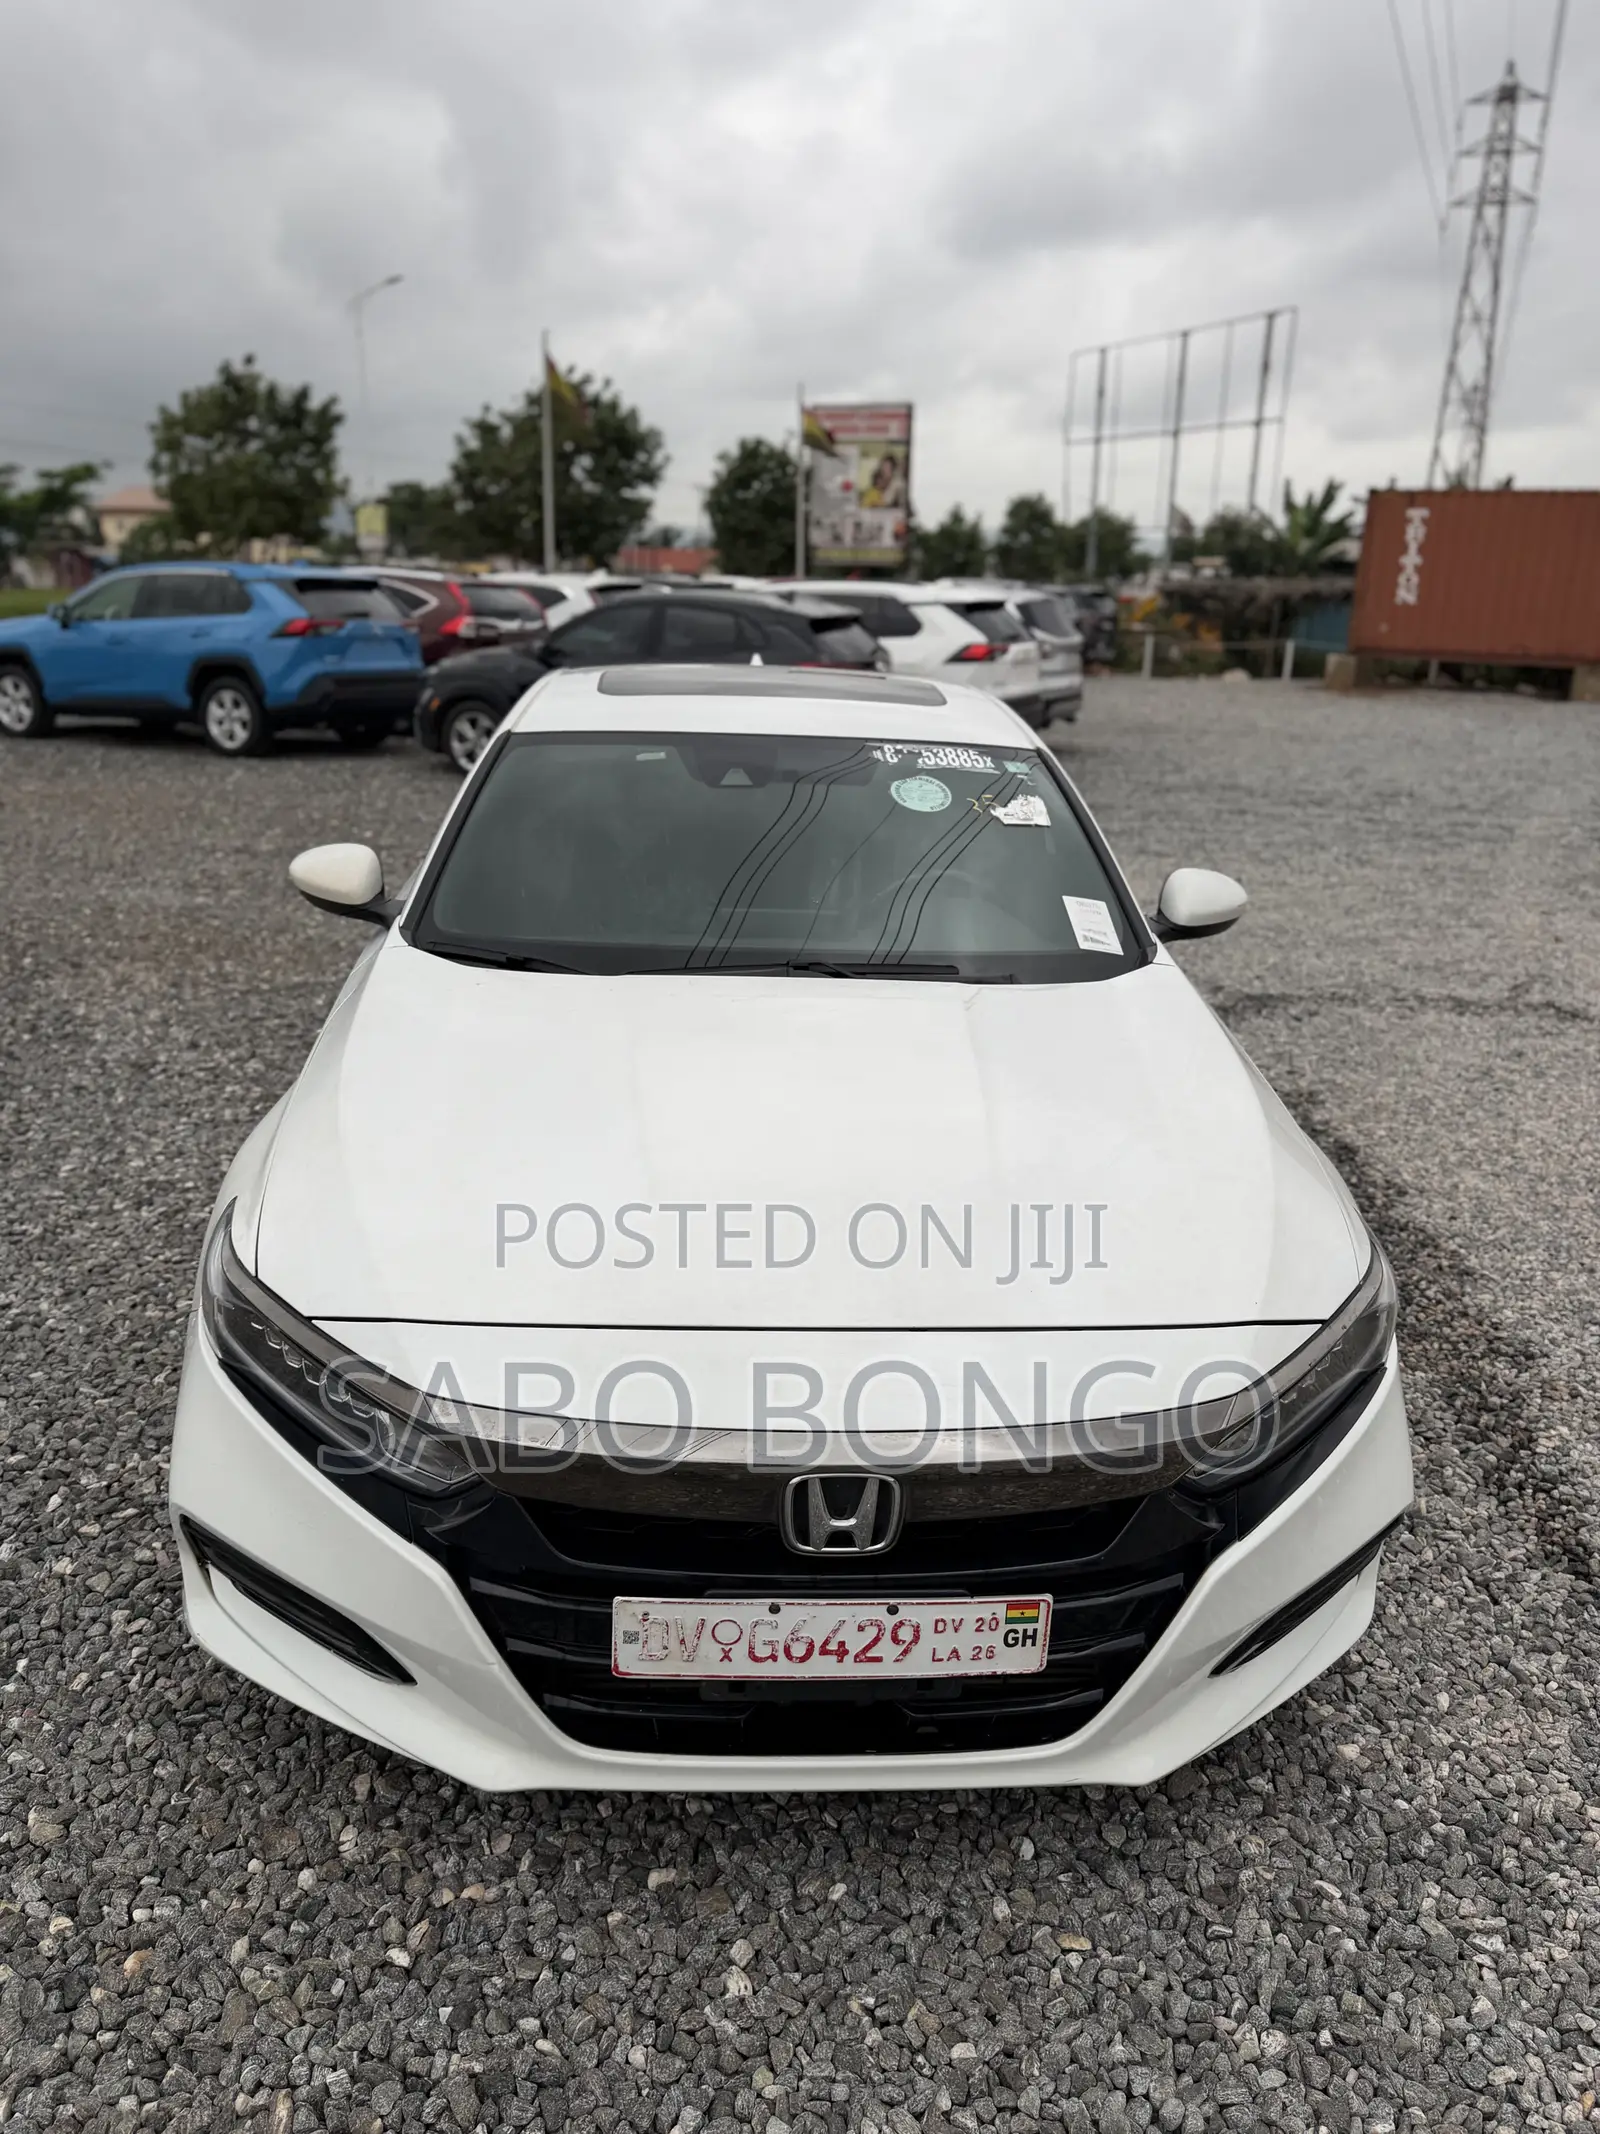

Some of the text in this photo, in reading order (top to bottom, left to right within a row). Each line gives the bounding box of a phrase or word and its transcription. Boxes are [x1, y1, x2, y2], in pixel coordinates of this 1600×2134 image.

[934, 1615, 1000, 1634] DV 20
[748, 1618, 921, 1664] G6429
[1003, 1627, 1039, 1649] GH
[931, 1646, 962, 1663] LA
